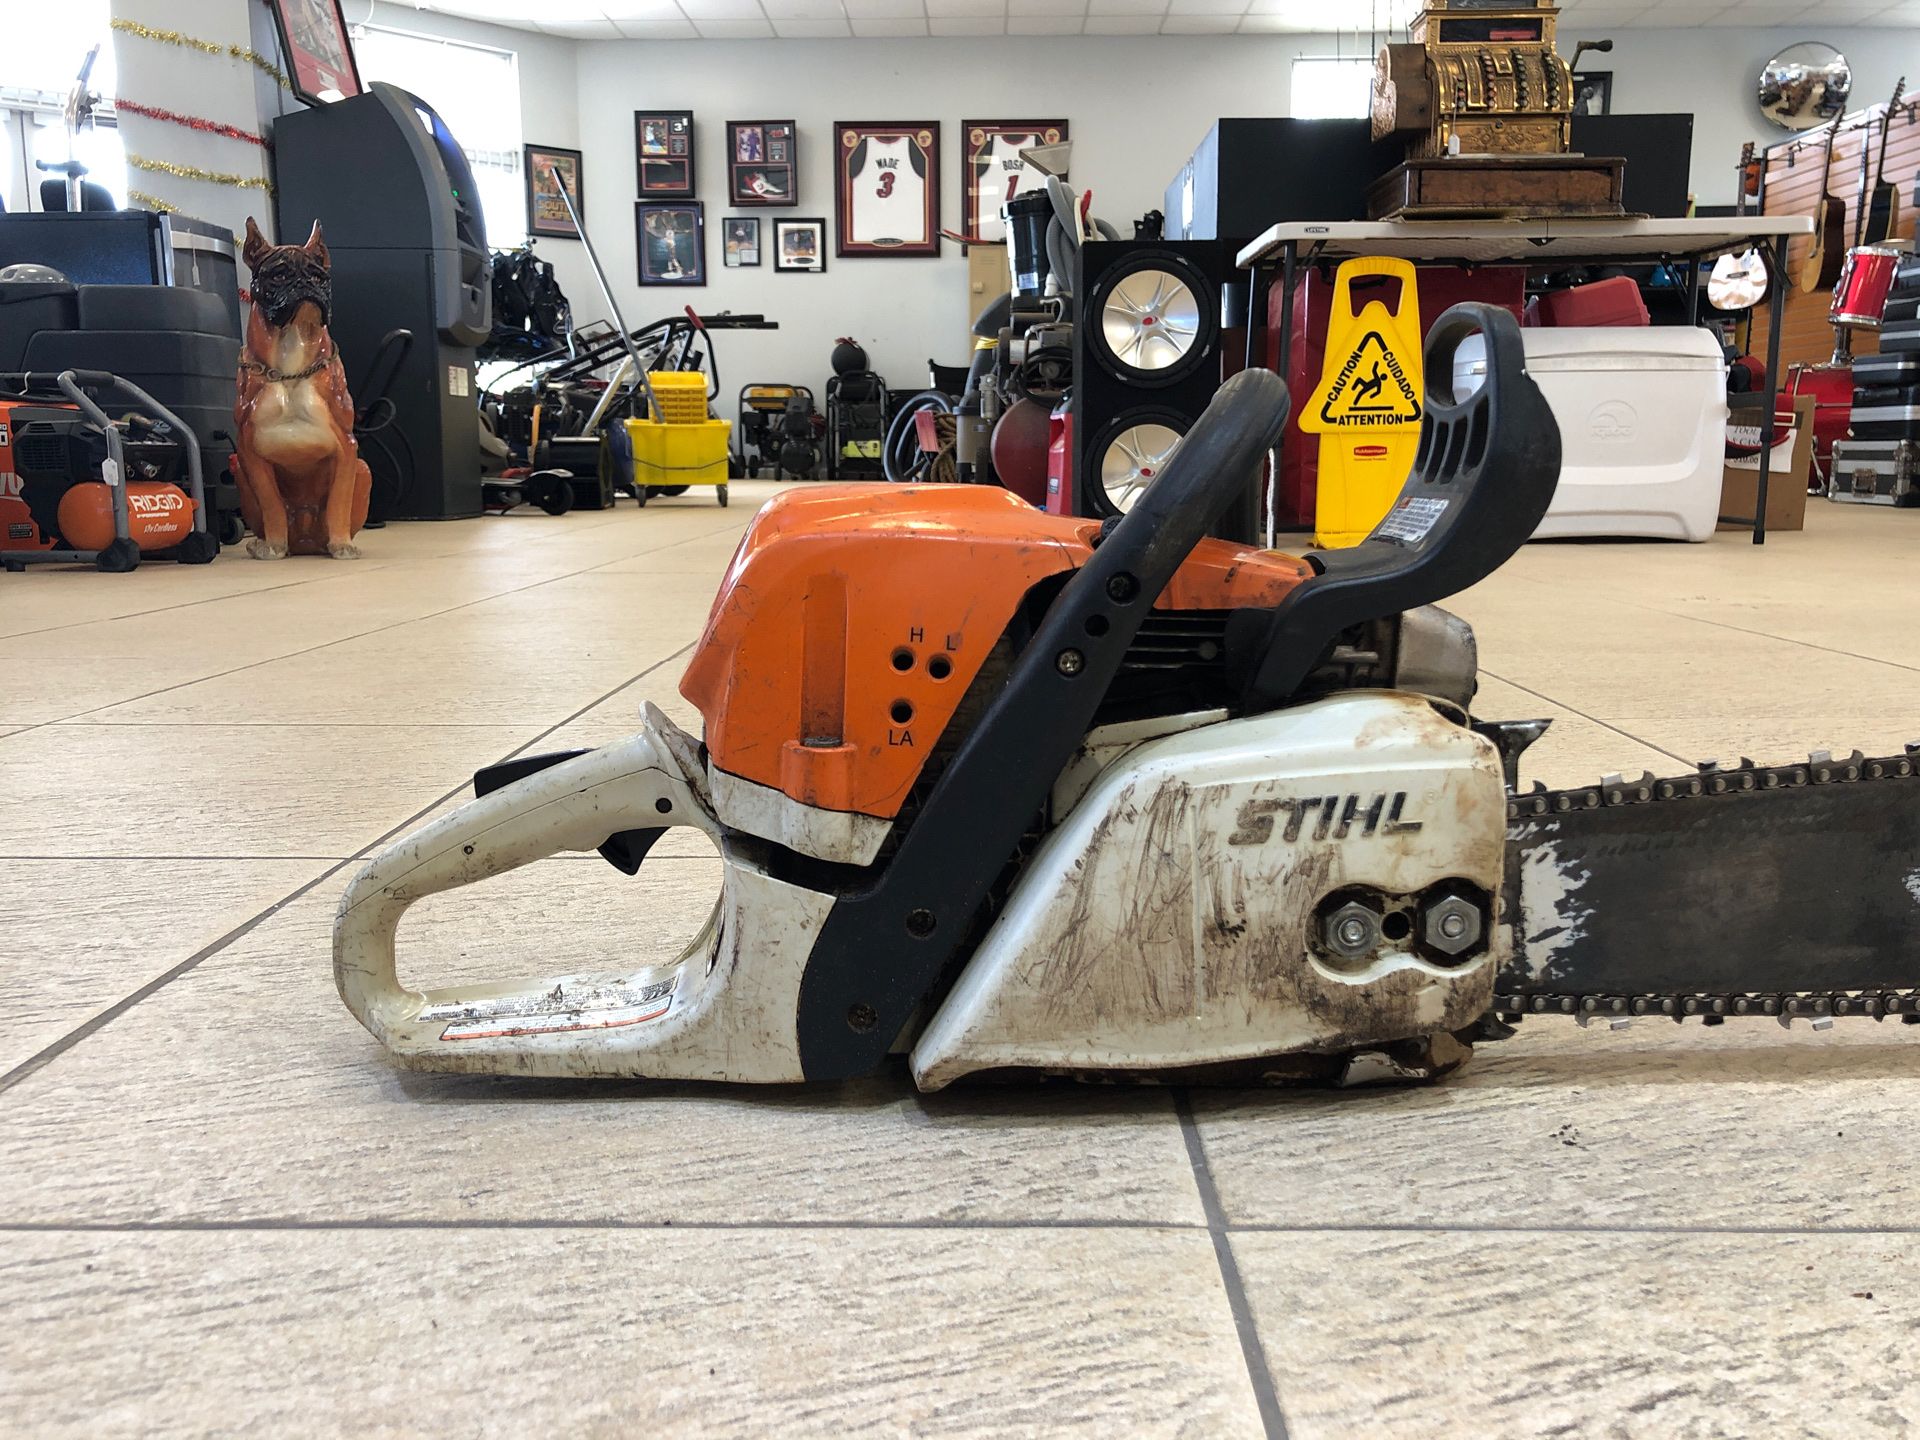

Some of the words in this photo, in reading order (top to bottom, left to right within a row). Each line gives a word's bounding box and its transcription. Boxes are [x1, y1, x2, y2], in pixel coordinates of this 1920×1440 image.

[875, 158, 900, 170] WADE
[1002, 159, 1025, 171] BOSH
[876, 171, 896, 198] 3
[1005, 174, 1019, 201] 1
[1327, 351, 1362, 402] CAUTION
[1383, 351, 1415, 400] CUIDADO
[1338, 414, 1403, 426] ATTENTION
[129, 494, 183, 512] RIDGID
[910, 627, 923, 642] H
[946, 635, 957, 651] L
[889, 729, 914, 747] LA
[1228, 791, 1424, 846] STIHL
